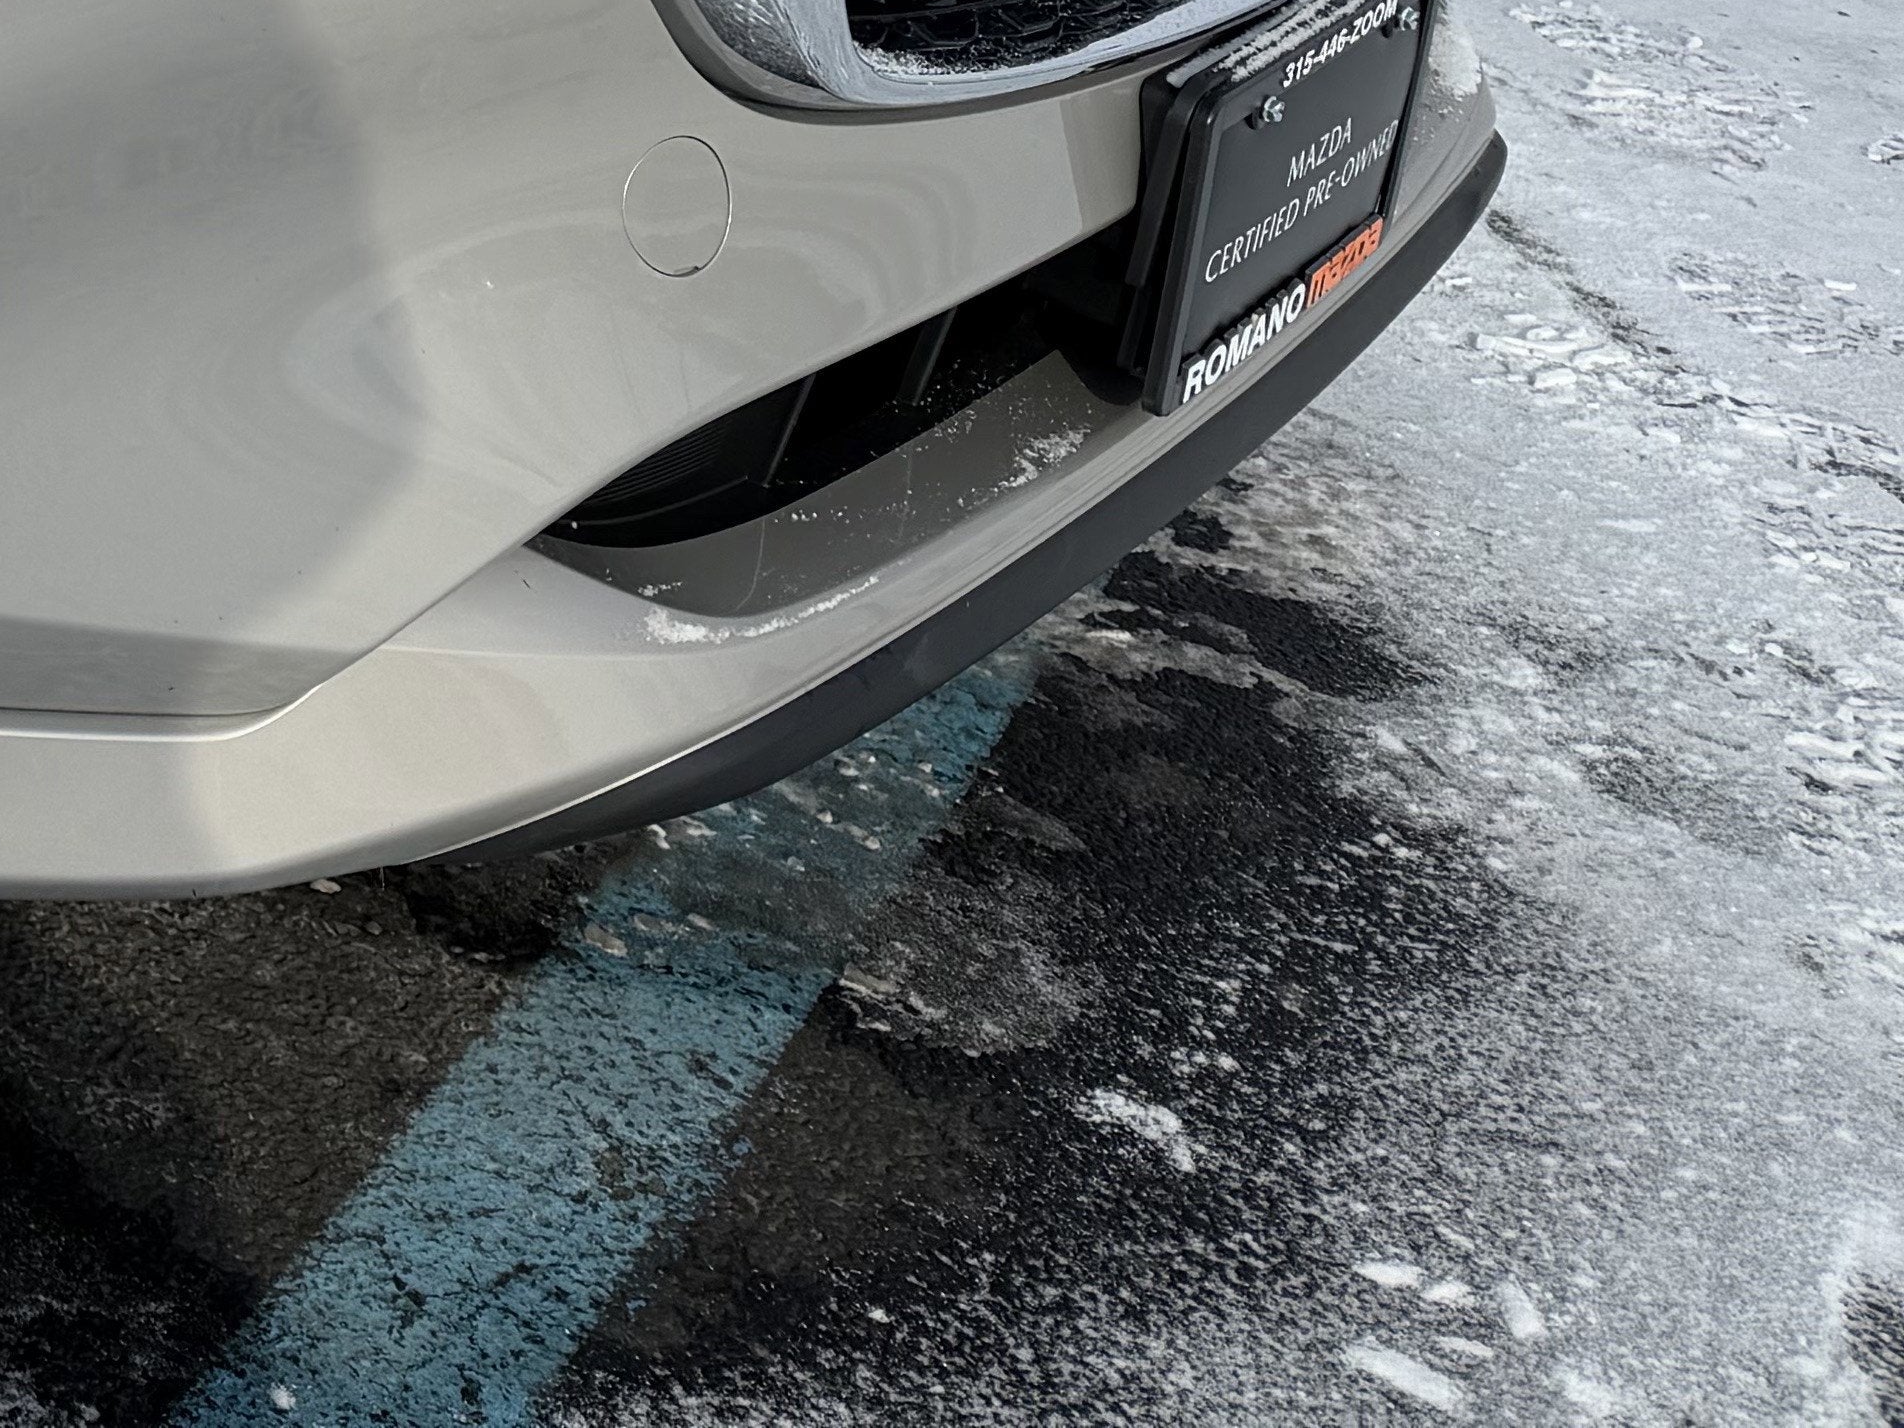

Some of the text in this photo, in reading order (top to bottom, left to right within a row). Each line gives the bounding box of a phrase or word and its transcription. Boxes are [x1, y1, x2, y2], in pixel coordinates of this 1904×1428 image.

[1205, 119, 1398, 282] CERTIFIED PRE-OWNED
[1286, 117, 1352, 188] MAZDA
[1183, 282, 1306, 404] ROMANO
